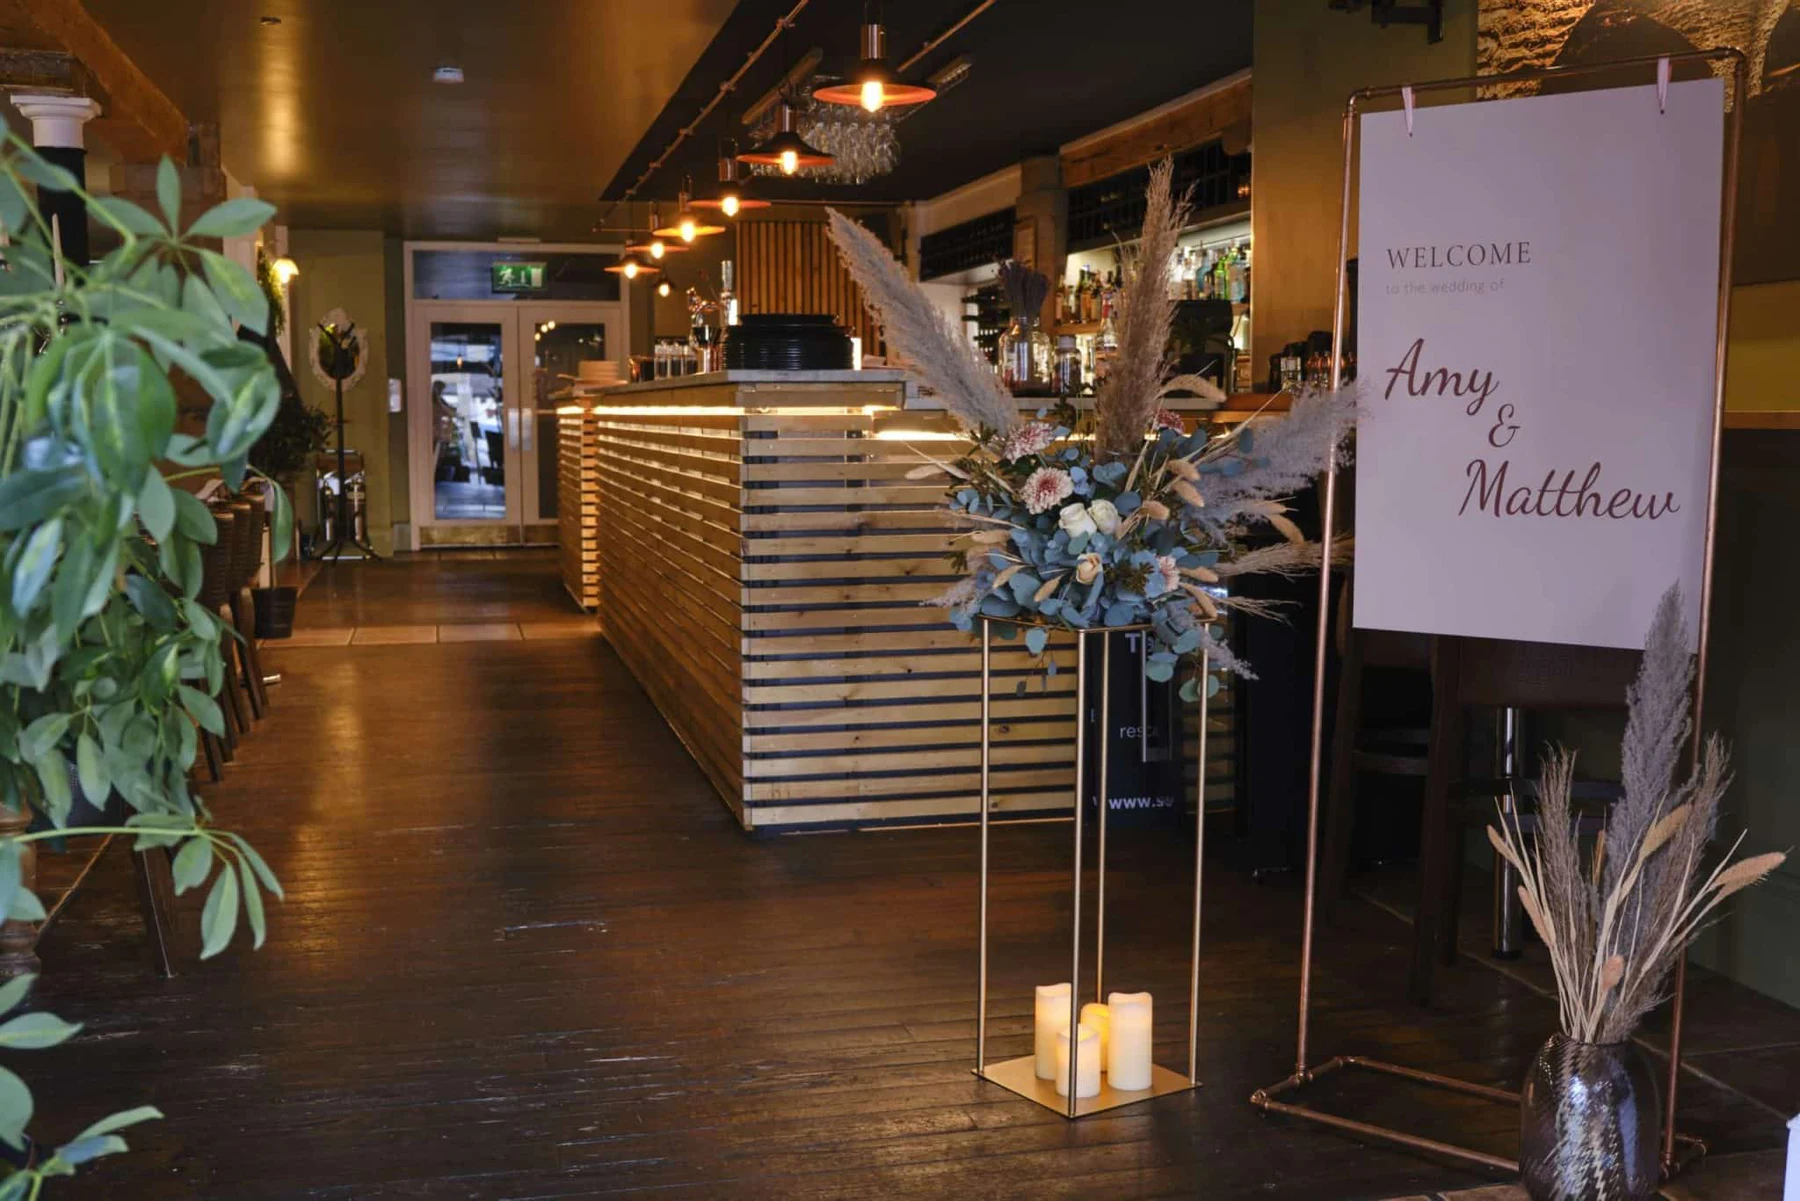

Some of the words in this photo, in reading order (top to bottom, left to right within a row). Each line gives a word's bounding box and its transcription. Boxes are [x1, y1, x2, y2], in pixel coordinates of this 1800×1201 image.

[1387, 241, 1531, 269] WELCOME
[1386, 284, 1400, 296] to
[1404, 282, 1426, 295] the
[1431, 279, 1485, 295] wedding
[1490, 278, 1505, 292] of
[1385, 338, 1500, 416] Amy
[1488, 403, 1521, 448] &
[1459, 458, 1681, 520] Matthew
